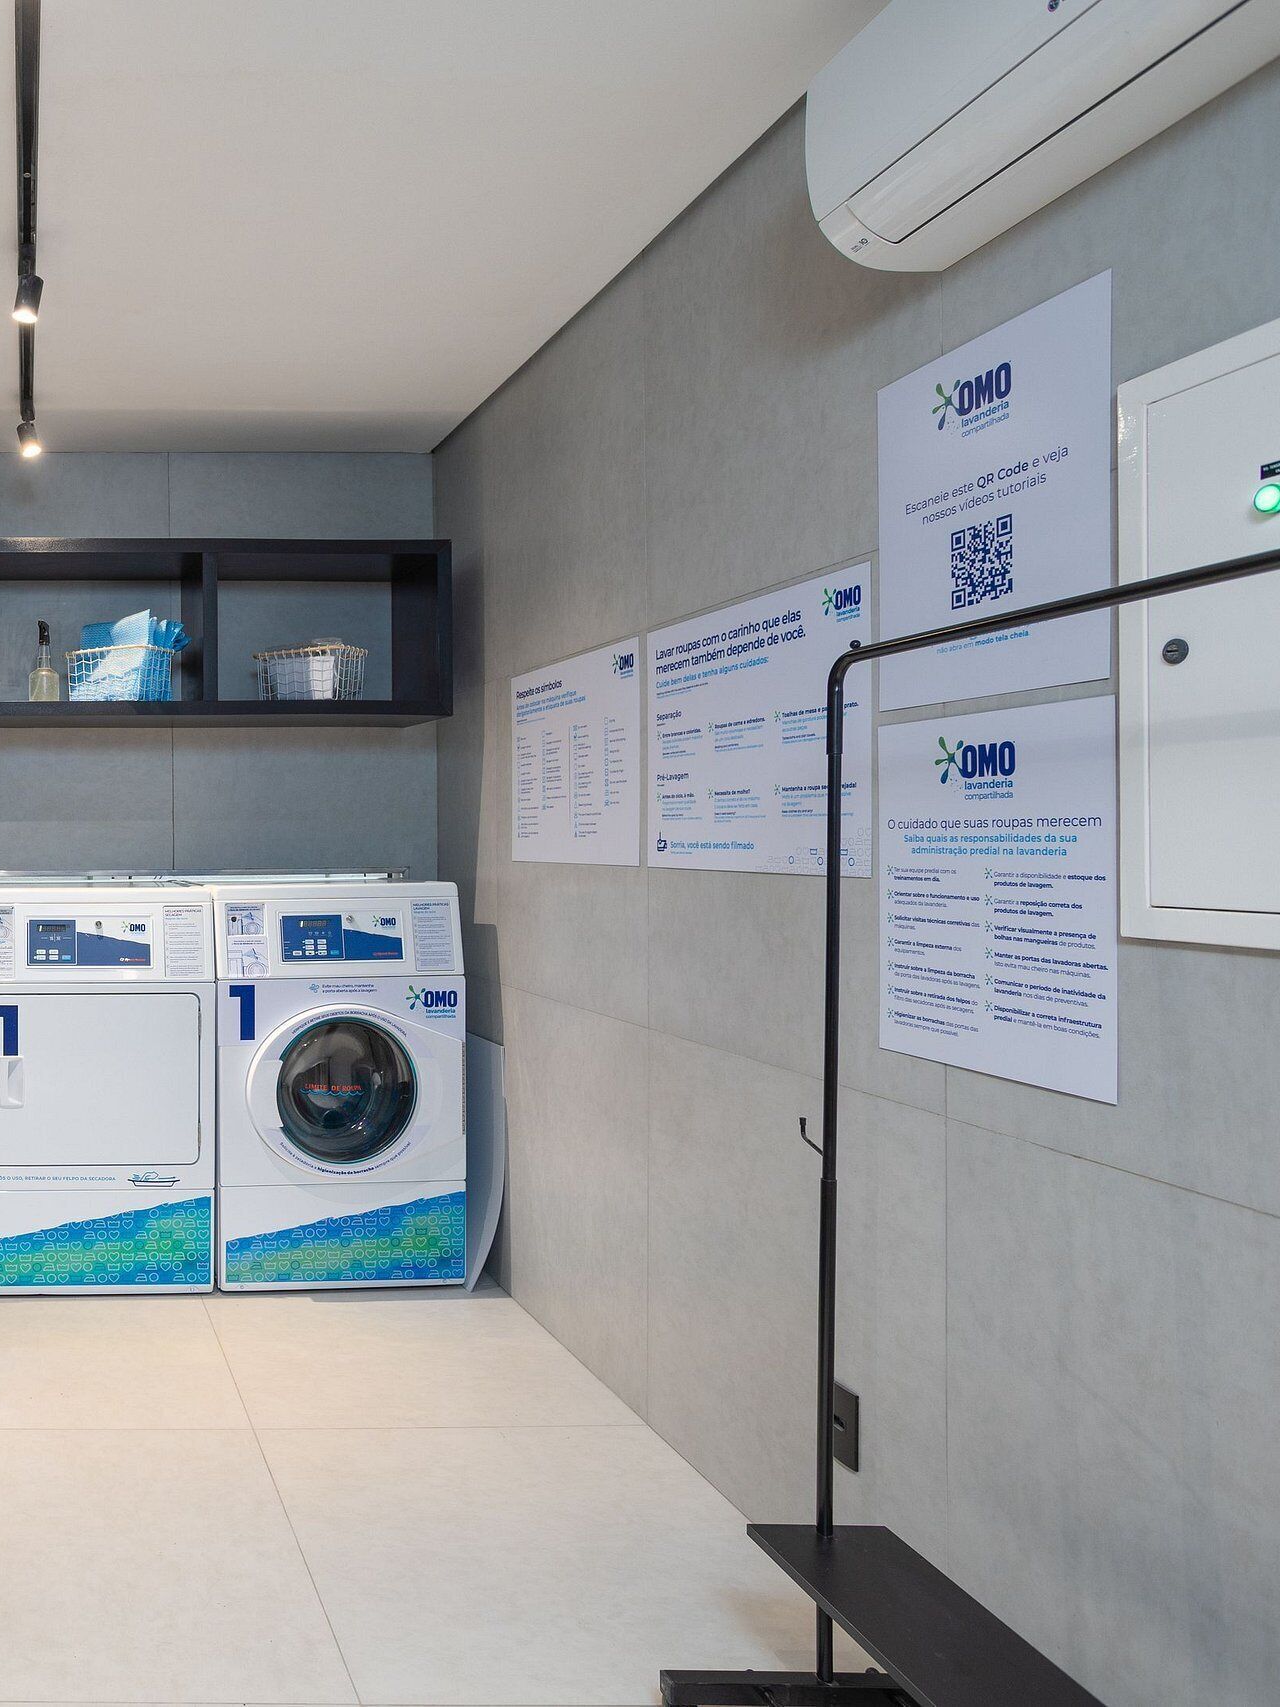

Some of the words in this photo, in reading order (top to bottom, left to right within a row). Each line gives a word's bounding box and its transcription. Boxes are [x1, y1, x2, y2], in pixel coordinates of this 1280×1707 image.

[958, 362, 1011, 416] OMO
[961, 401, 1009, 427] lavanderia
[961, 413, 1009, 438] compartilhada
[906, 491, 949, 515] Escaneie
[951, 483, 974, 498] este
[977, 473, 994, 489] QR
[998, 461, 1029, 481] Code
[1032, 458, 1040, 468] e
[1043, 446, 1068, 464] veja
[922, 505, 956, 525] nossos
[960, 492, 994, 512] vídeos
[997, 473, 1047, 499] tutoriais
[835, 585, 861, 610] OMO
[656, 649, 675, 660] Lavar
[676, 640, 701, 655] roupas
[702, 634, 720, 647] com
[721, 634, 726, 642] o
[728, 621, 760, 640] carinho
[762, 618, 780, 633] que
[782, 609, 801, 625] elas
[975, 637, 993, 646] modo
[995, 634, 1008, 642] tela
[1010, 630, 1029, 639] cheia
[656, 660, 690, 675] merecem
[691, 645, 725, 666] também
[727, 637, 765, 656] depende
[767, 633, 779, 646] de
[781, 625, 806, 642] você.
[620, 653, 633, 670] OMO
[656, 680, 670, 689] Cuide
[671, 675, 682, 686] bem
[683, 672, 696, 683] delas
[702, 668, 718, 678] tenha
[719, 664, 738, 675] alguns
[740, 656, 769, 670] cuidados:
[657, 710, 682, 721] Separação
[961, 741, 1016, 778] OMO
[657, 773, 689, 781] Pré-Lavagem
[964, 779, 1013, 790] lavanderia
[964, 791, 1013, 801] compartilhada
[888, 820, 895, 829] O
[898, 818, 937, 829] cuidado
[941, 820, 961, 831] que
[964, 819, 989, 828] suas
[992, 817, 1032, 830] roupas
[1037, 816, 1102, 828] merecem
[670, 840, 686, 849] Sorria,
[687, 840, 699, 849] você
[701, 841, 712, 849] está
[713, 841, 730, 849] sendo
[731, 841, 754, 849] filmado
[904, 834, 925, 843] Saiba
[927, 834, 947, 845] quais
[961, 834, 1041, 844] responsabilidades
[1044, 834, 1057, 843] da
[1059, 835, 1077, 843] sua
[912, 845, 967, 857] administração
[970, 846, 1000, 858] predial
[1003, 848, 1014, 856] na
[1016, 847, 1067, 856] lavanderia
[1028, 881, 1053, 889] lavagem.
[1020, 900, 1047, 909] reposição
[1028, 909, 1053, 917] lavagem.
[129, 924, 146, 932] OMO
[380, 917, 396, 926] OMO
[1018, 926, 1052, 936] visualmente
[1059, 932, 1086, 940] presença
[1022, 955, 1039, 963] portas
[1052, 959, 1081, 967] lavadoras
[1083, 962, 1108, 971] abertas.
[424, 991, 458, 1008] OMO
[229, 985, 255, 1040] 1
